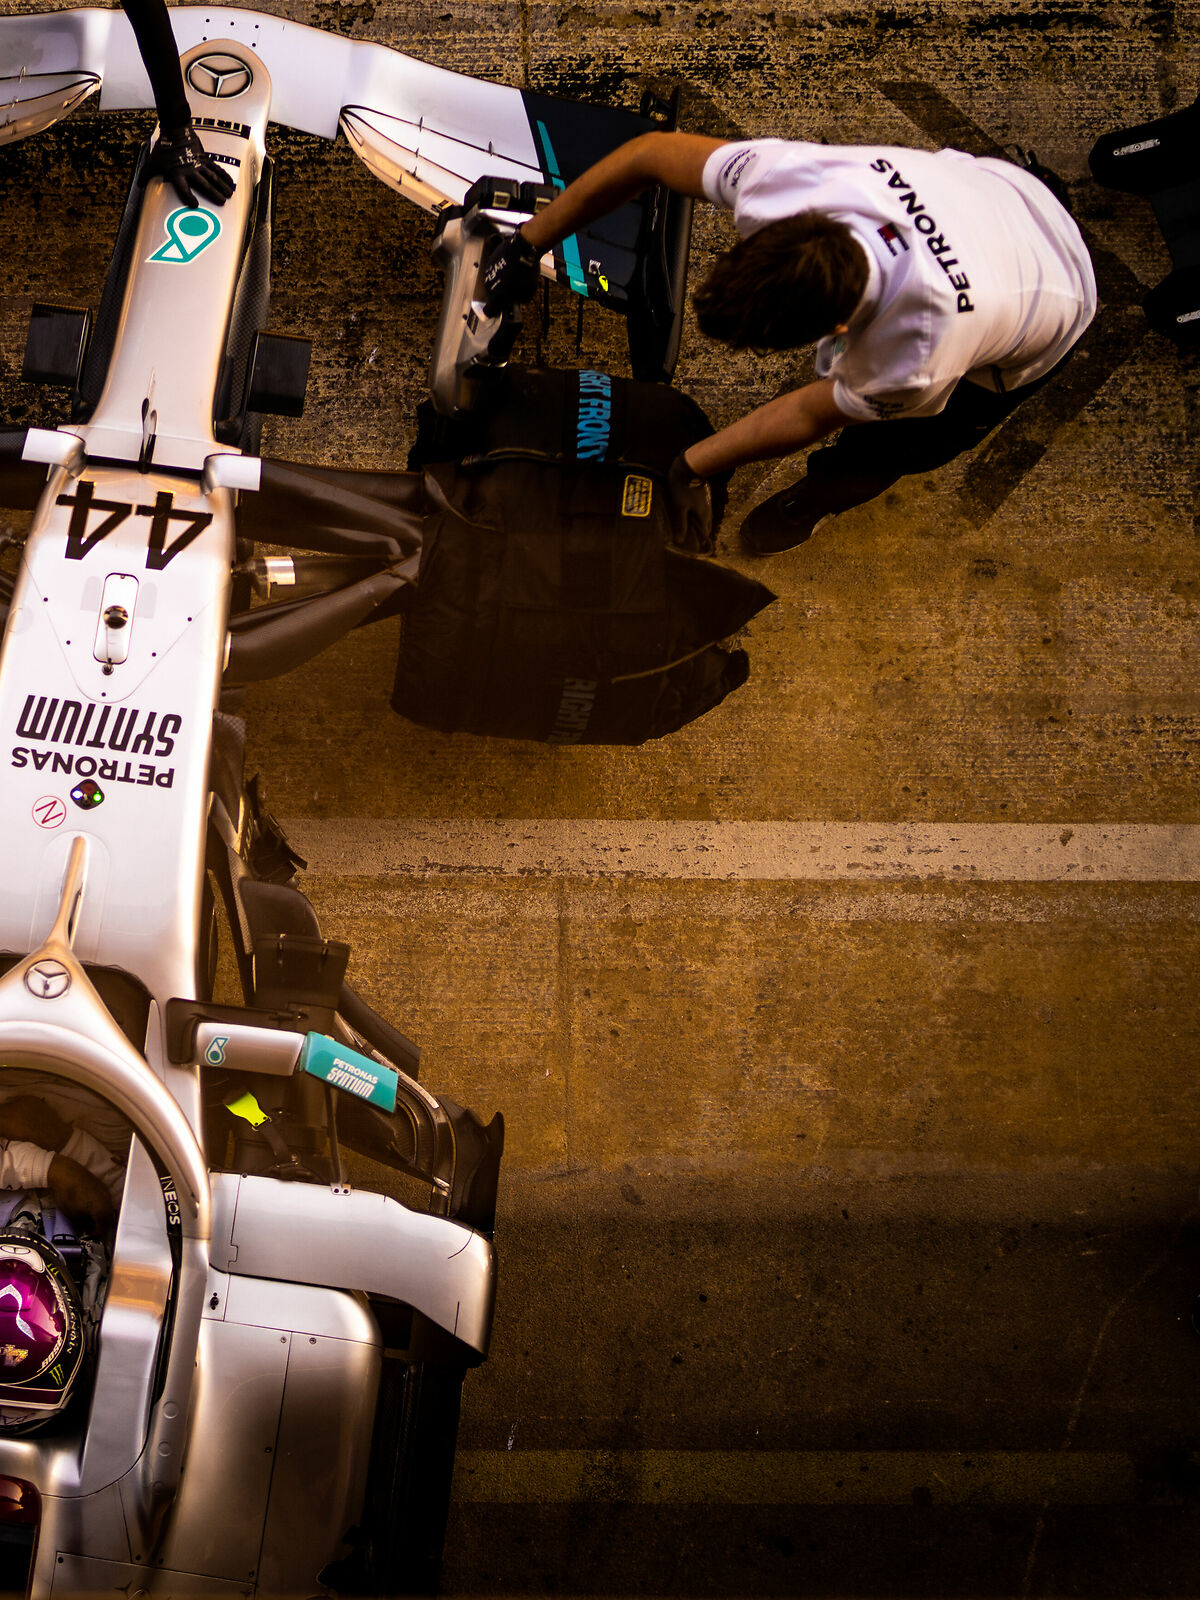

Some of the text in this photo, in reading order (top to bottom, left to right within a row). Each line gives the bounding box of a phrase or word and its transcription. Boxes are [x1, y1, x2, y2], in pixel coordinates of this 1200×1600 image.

[870, 158, 975, 314] PETRONAS
[575, 398, 611, 463] FRONT
[55, 480, 214, 571] 44
[15, 694, 182, 757] SYNTIUM
[11, 746, 176, 789] PETRONAS
[326, 1066, 376, 1099] SYNTIUM
[333, 1057, 379, 1085] PETRONAS
[160, 1175, 182, 1226] INEOS
